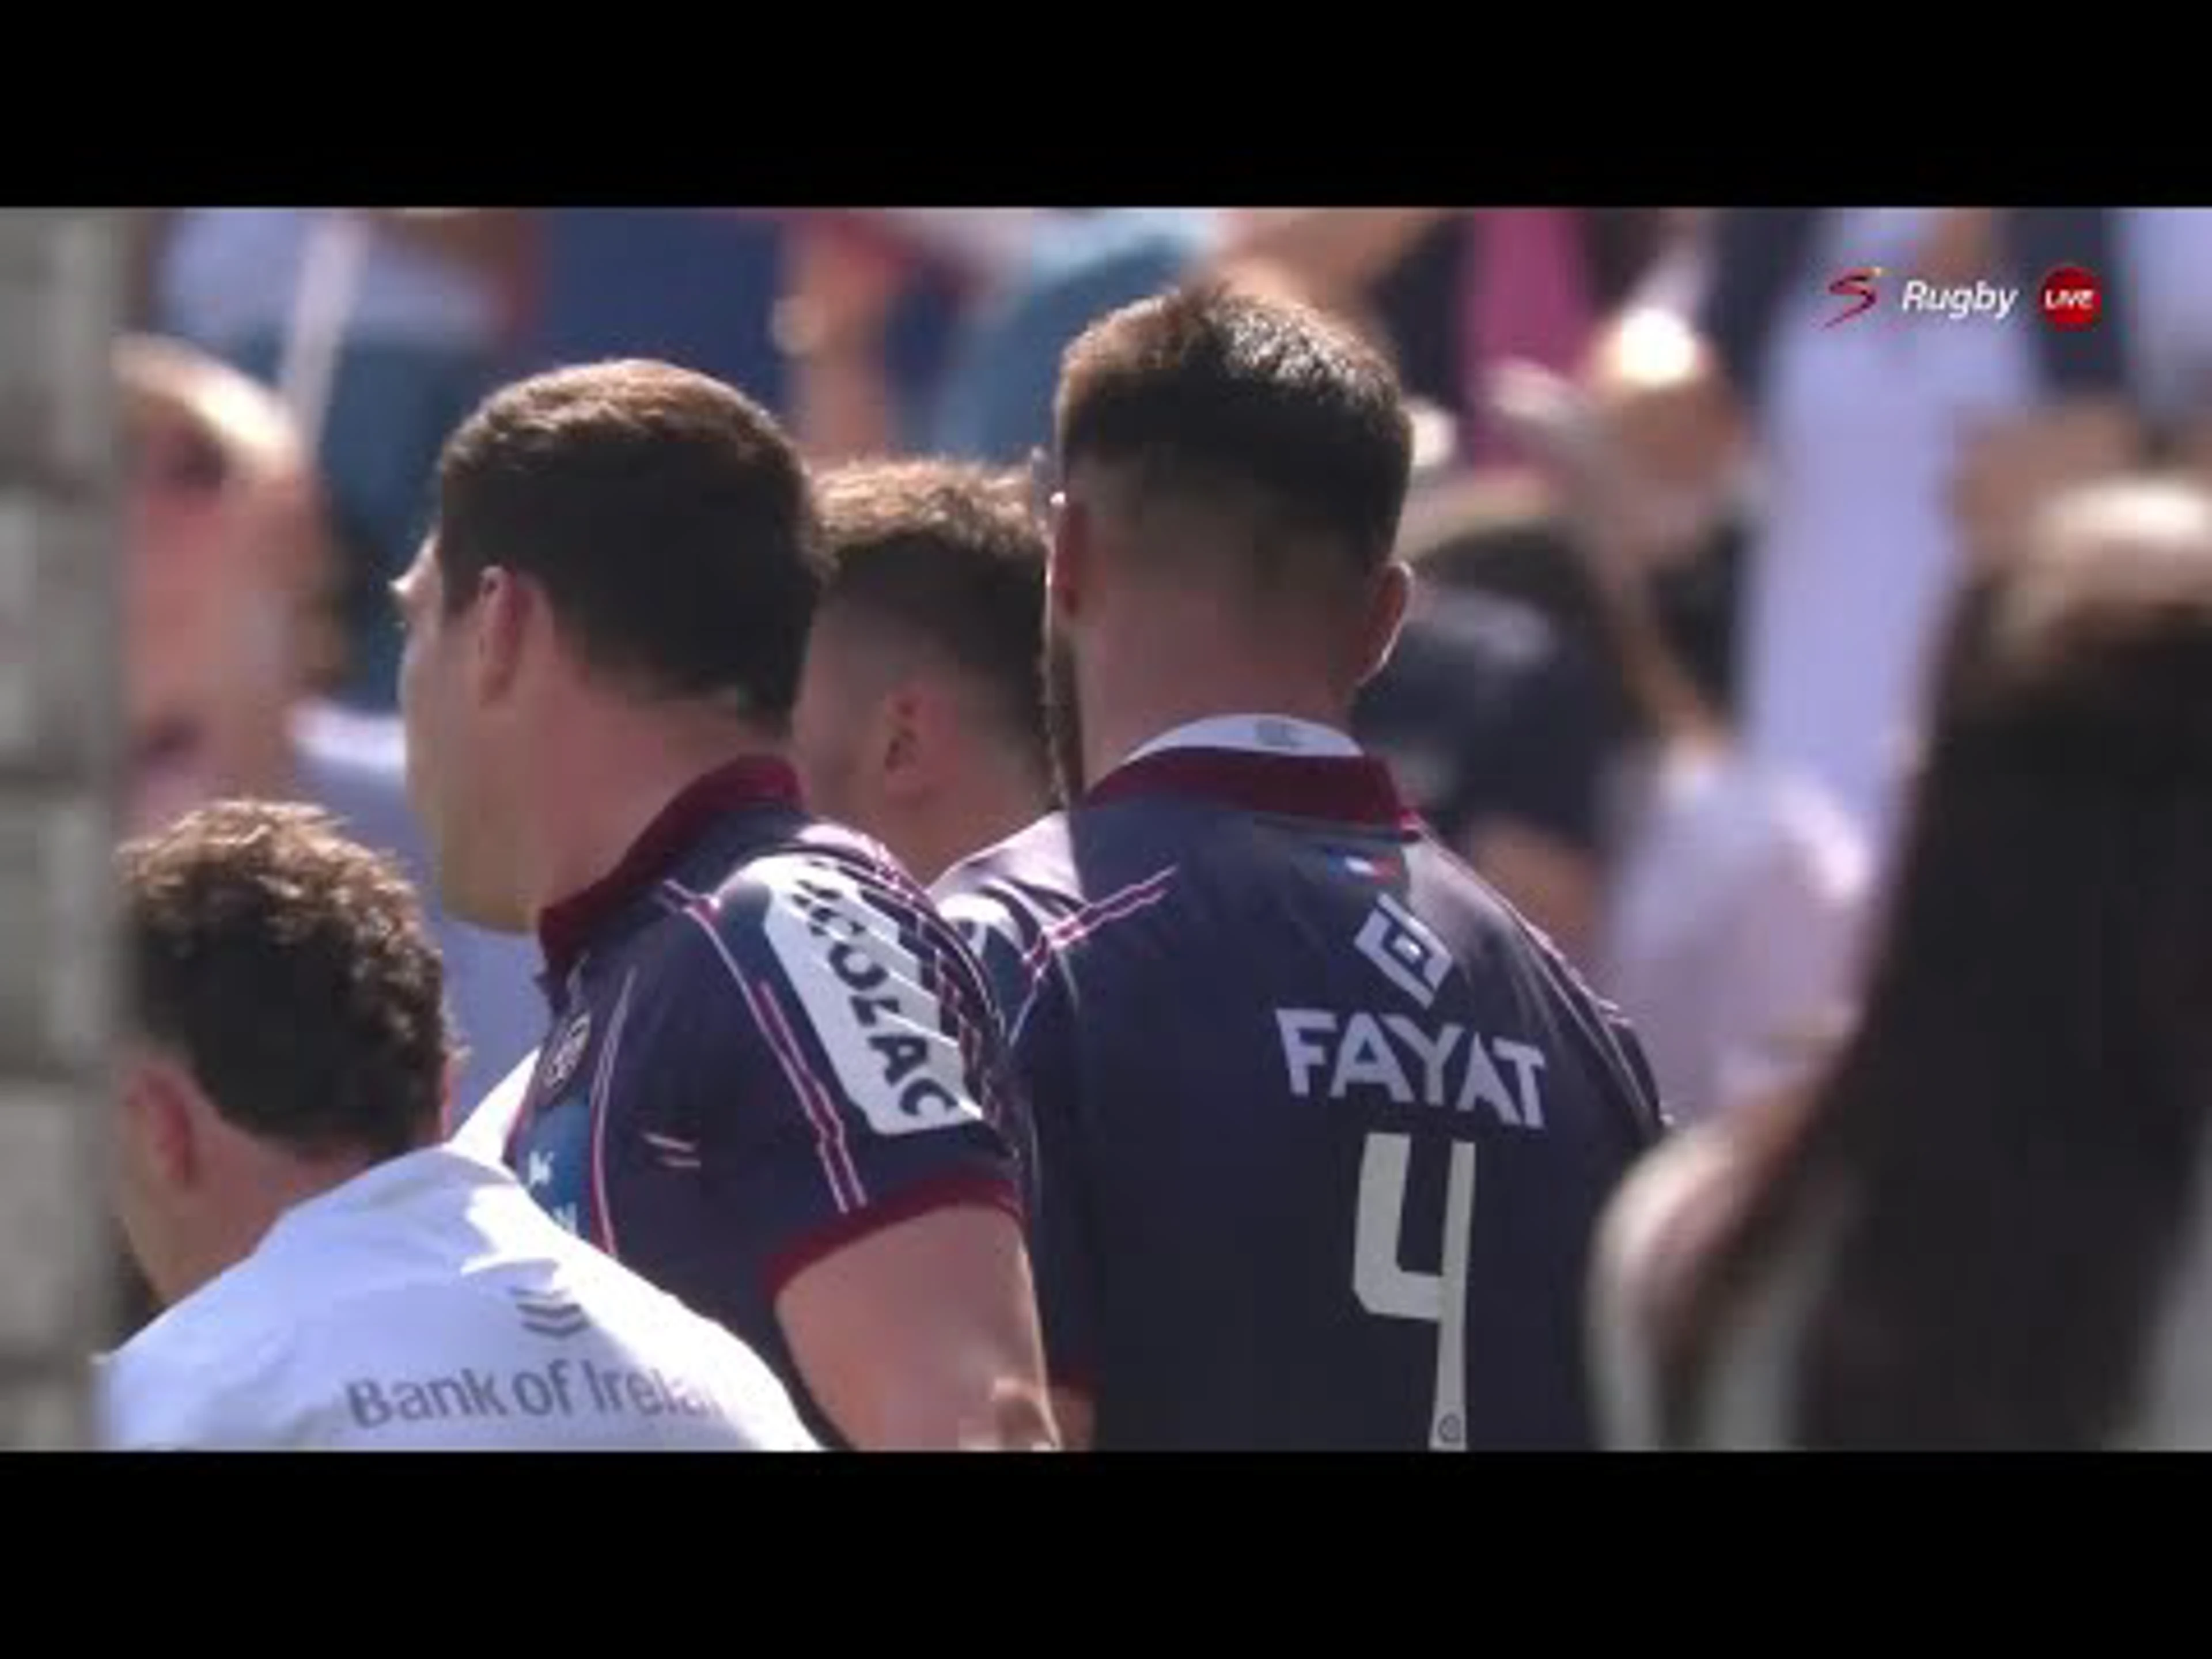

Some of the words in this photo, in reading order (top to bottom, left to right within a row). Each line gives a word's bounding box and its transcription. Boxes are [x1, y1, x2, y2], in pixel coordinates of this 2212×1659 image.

[1275, 1008, 1547, 1129] FAYAT
[1352, 1132, 1476, 1452] 4
[347, 1369, 509, 1429] Bank
[512, 1358, 574, 1417] of
